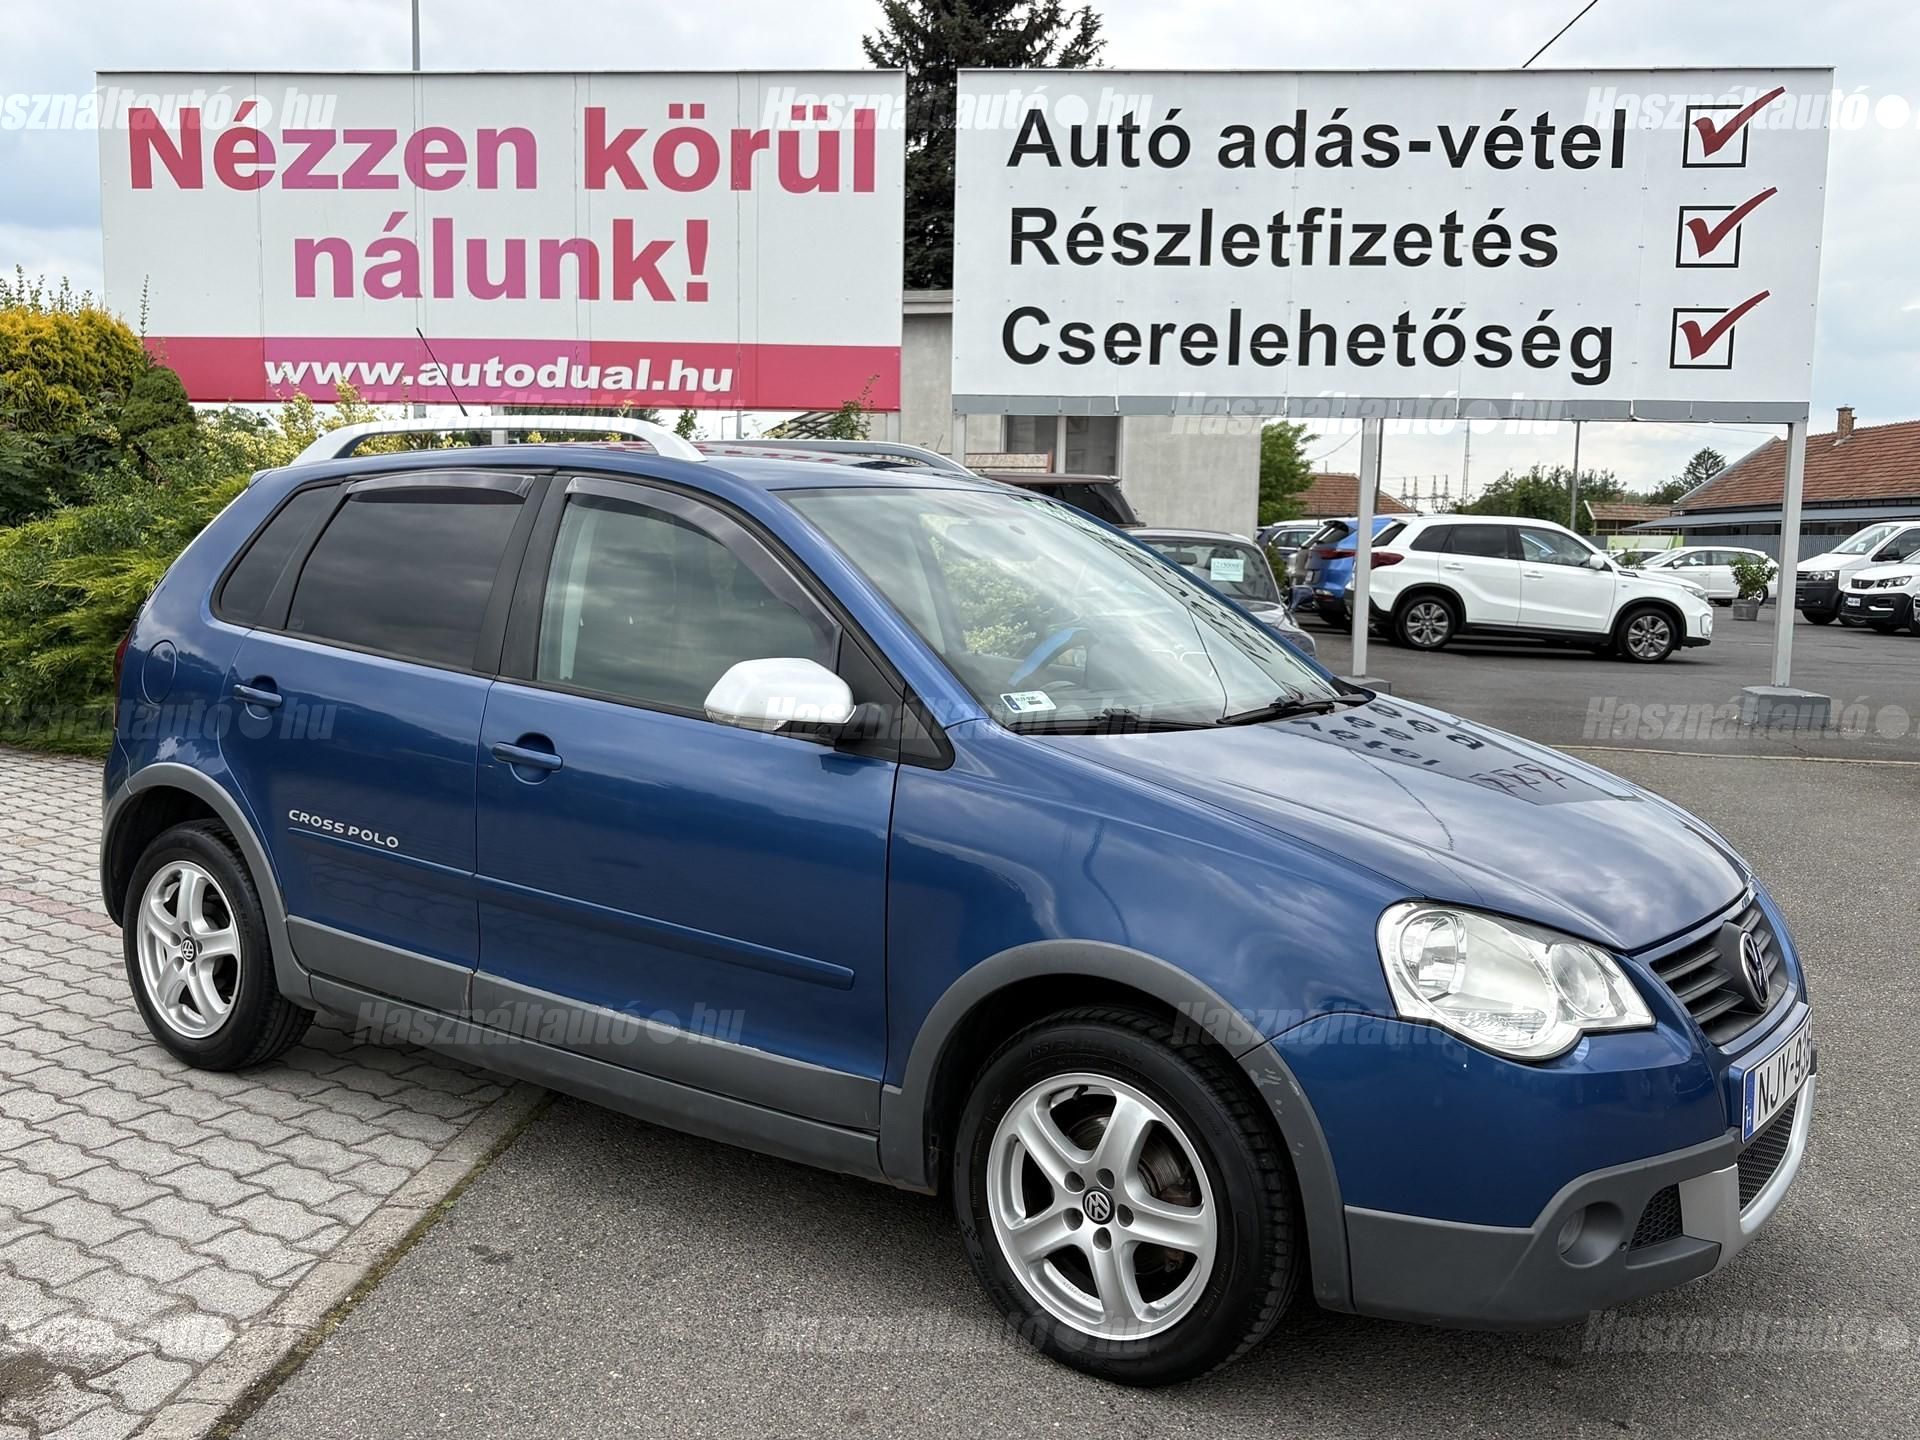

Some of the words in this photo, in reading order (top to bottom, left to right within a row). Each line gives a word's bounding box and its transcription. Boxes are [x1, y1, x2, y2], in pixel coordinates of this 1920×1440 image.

[128, 101, 538, 191] Nézzen
[585, 103, 876, 193] körül
[1007, 107, 1192, 170] Autó
[1219, 107, 1625, 171] adás-vétel
[295, 211, 709, 303] nálunk!
[1010, 206, 1559, 269] Részletfizetés
[265, 354, 734, 393] www.autodual.hu
[1002, 306, 1613, 385] Cserelehetőség
[288, 809, 345, 834] CROSS
[347, 825, 400, 849] POLO
